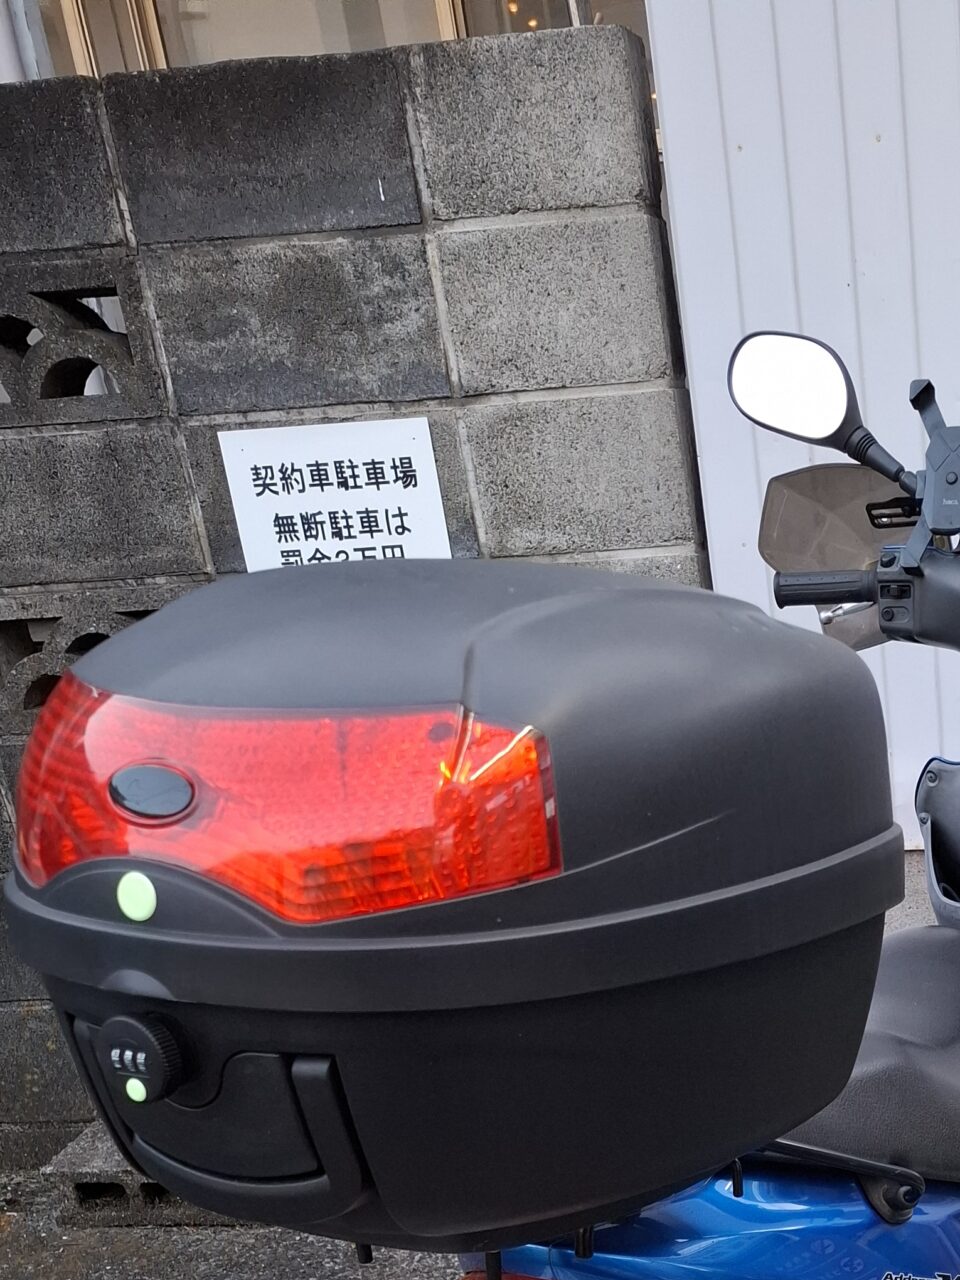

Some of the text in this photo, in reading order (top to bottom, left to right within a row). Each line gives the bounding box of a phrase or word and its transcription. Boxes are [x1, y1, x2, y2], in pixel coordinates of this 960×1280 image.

[250, 456, 419, 497] 契約車駐車場
[273, 506, 412, 543] 無断駐車は
